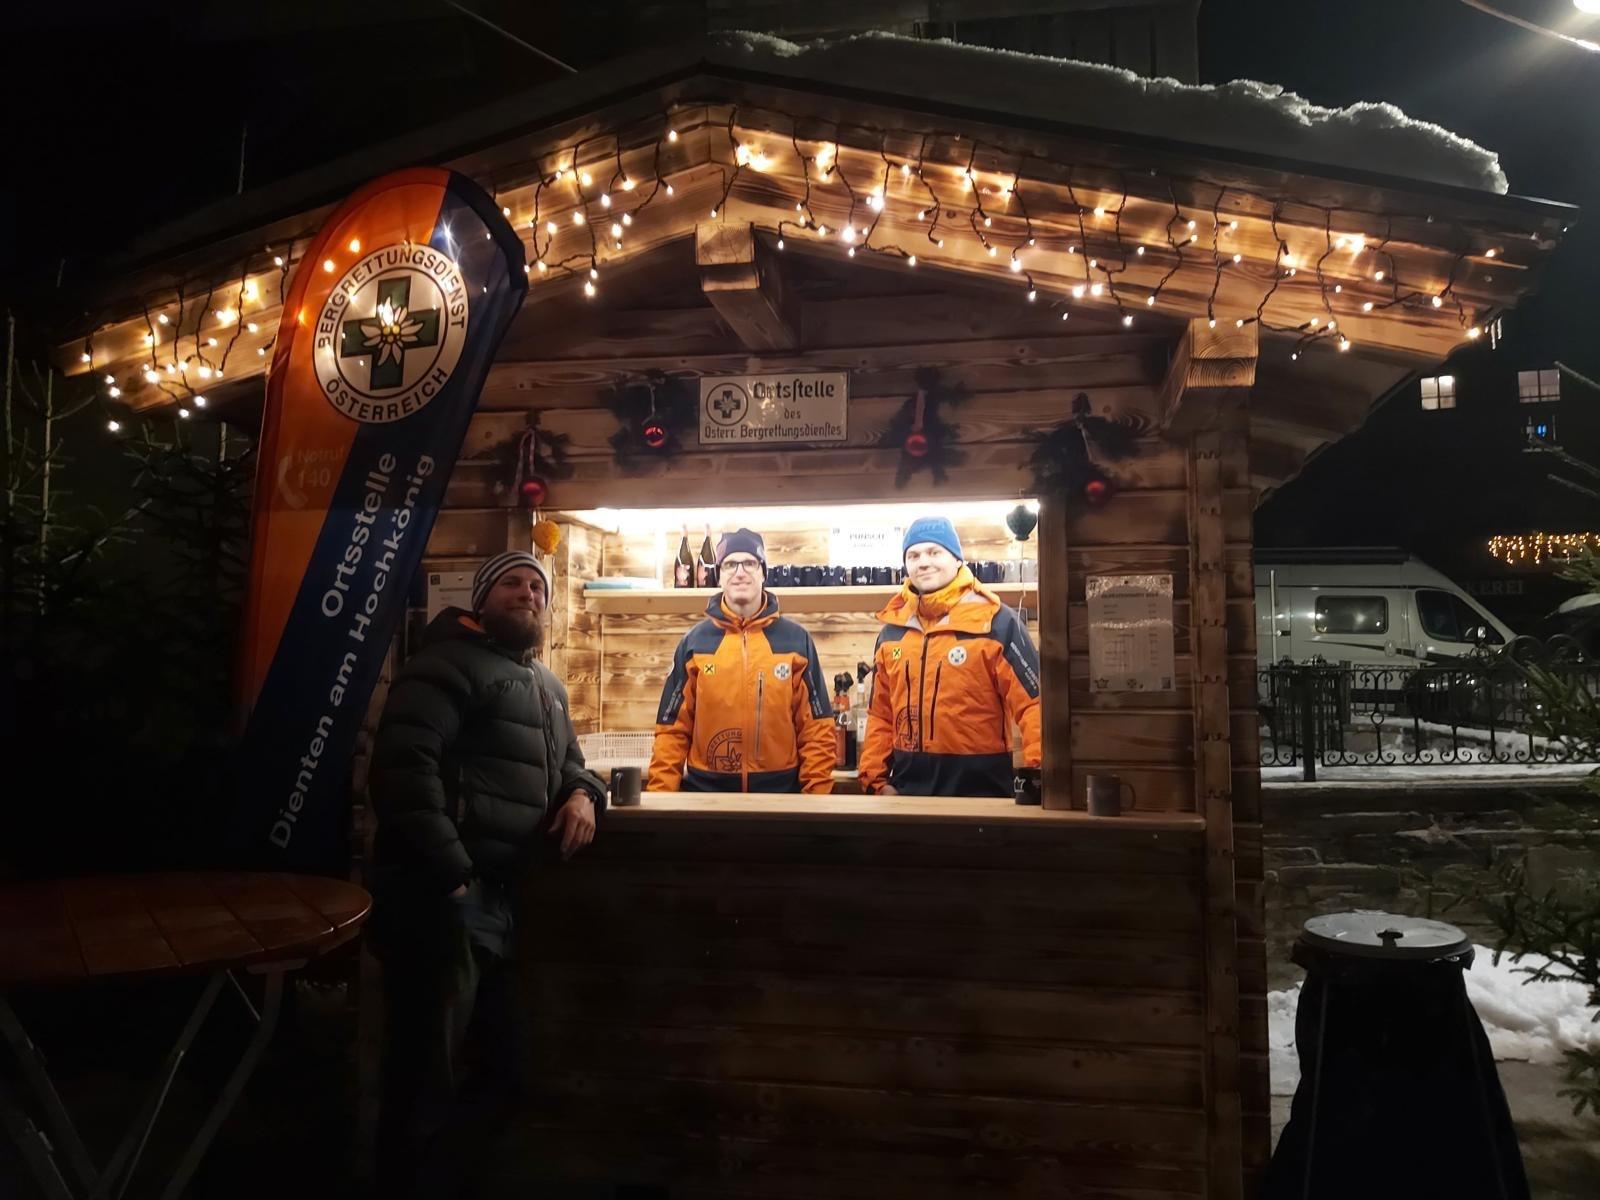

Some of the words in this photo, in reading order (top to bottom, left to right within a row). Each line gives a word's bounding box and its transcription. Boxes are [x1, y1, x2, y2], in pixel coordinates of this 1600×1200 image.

[318, 248, 464, 349] BERGRETTUNGSDIENST
[325, 367, 449, 421] ÖSTERREICH
[784, 408, 801, 420] des
[297, 467, 331, 488] 140
[321, 453, 397, 618] Ortsstelle
[269, 715, 333, 848] Dienten
[329, 652, 357, 707] am
[348, 454, 436, 643] Hochkönig
